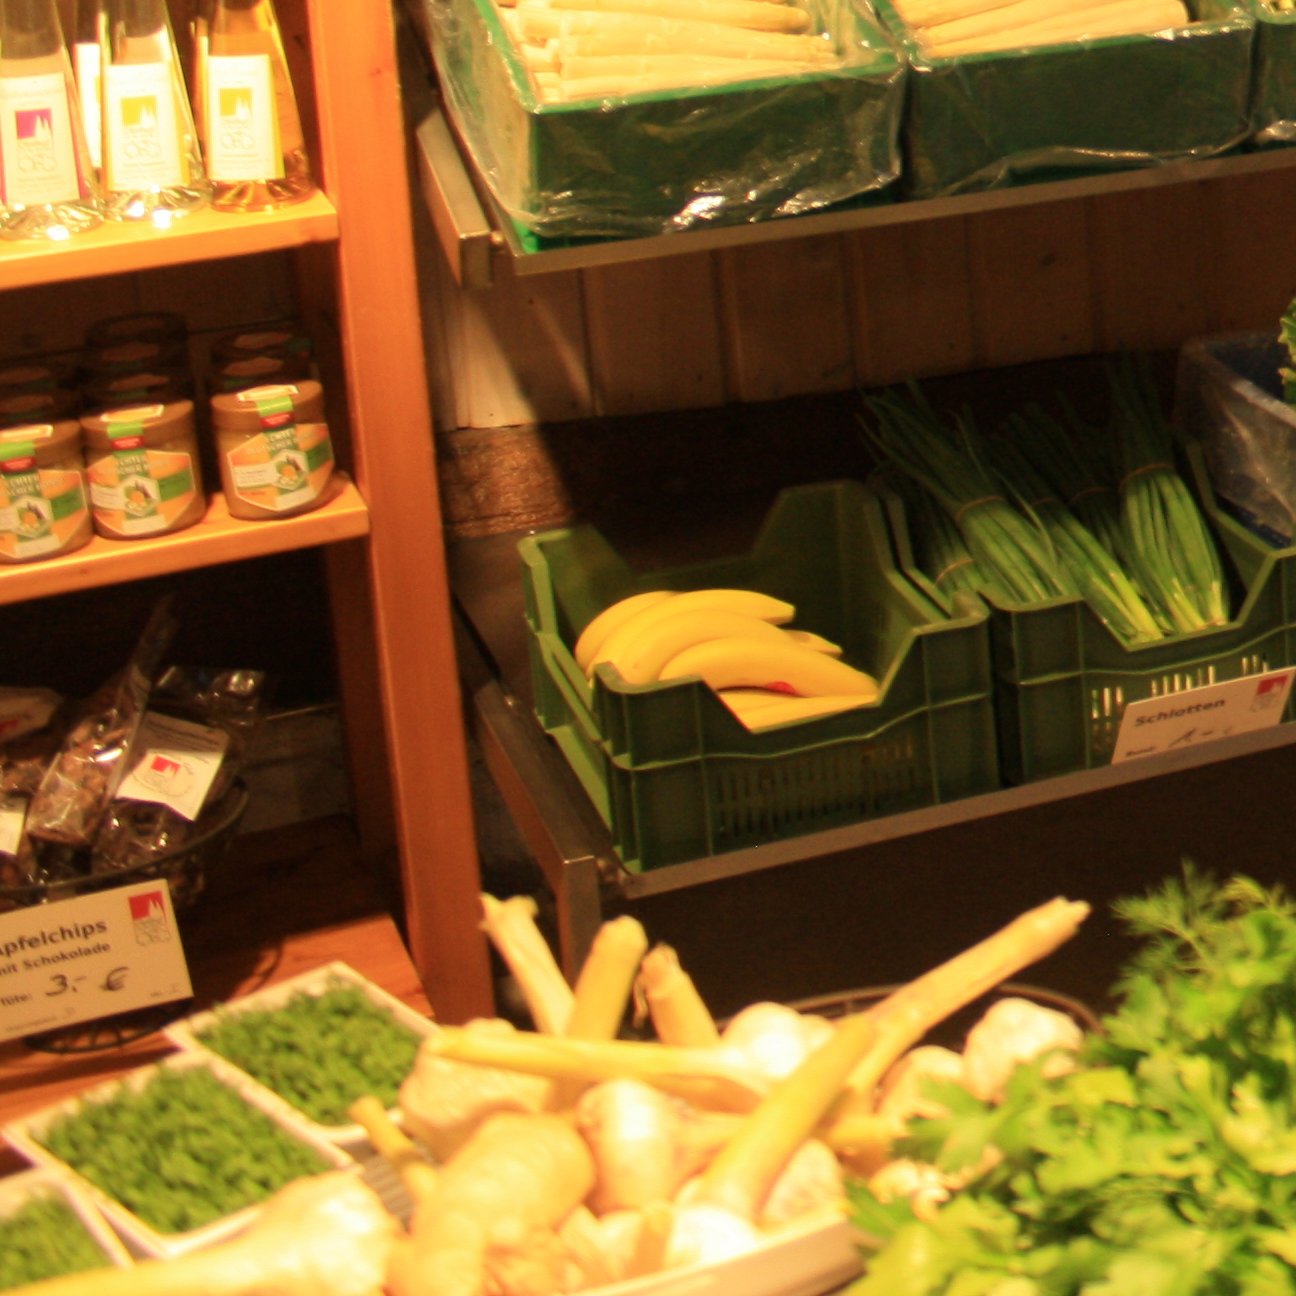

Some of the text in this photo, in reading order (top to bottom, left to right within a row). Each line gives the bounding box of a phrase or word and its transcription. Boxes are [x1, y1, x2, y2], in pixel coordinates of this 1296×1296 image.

[1133, 698, 1226, 727] Schlotten
[0, 920, 108, 957] pfelchips
[22, 942, 112, 970] Schokolade
[101, 965, 130, 991] €
